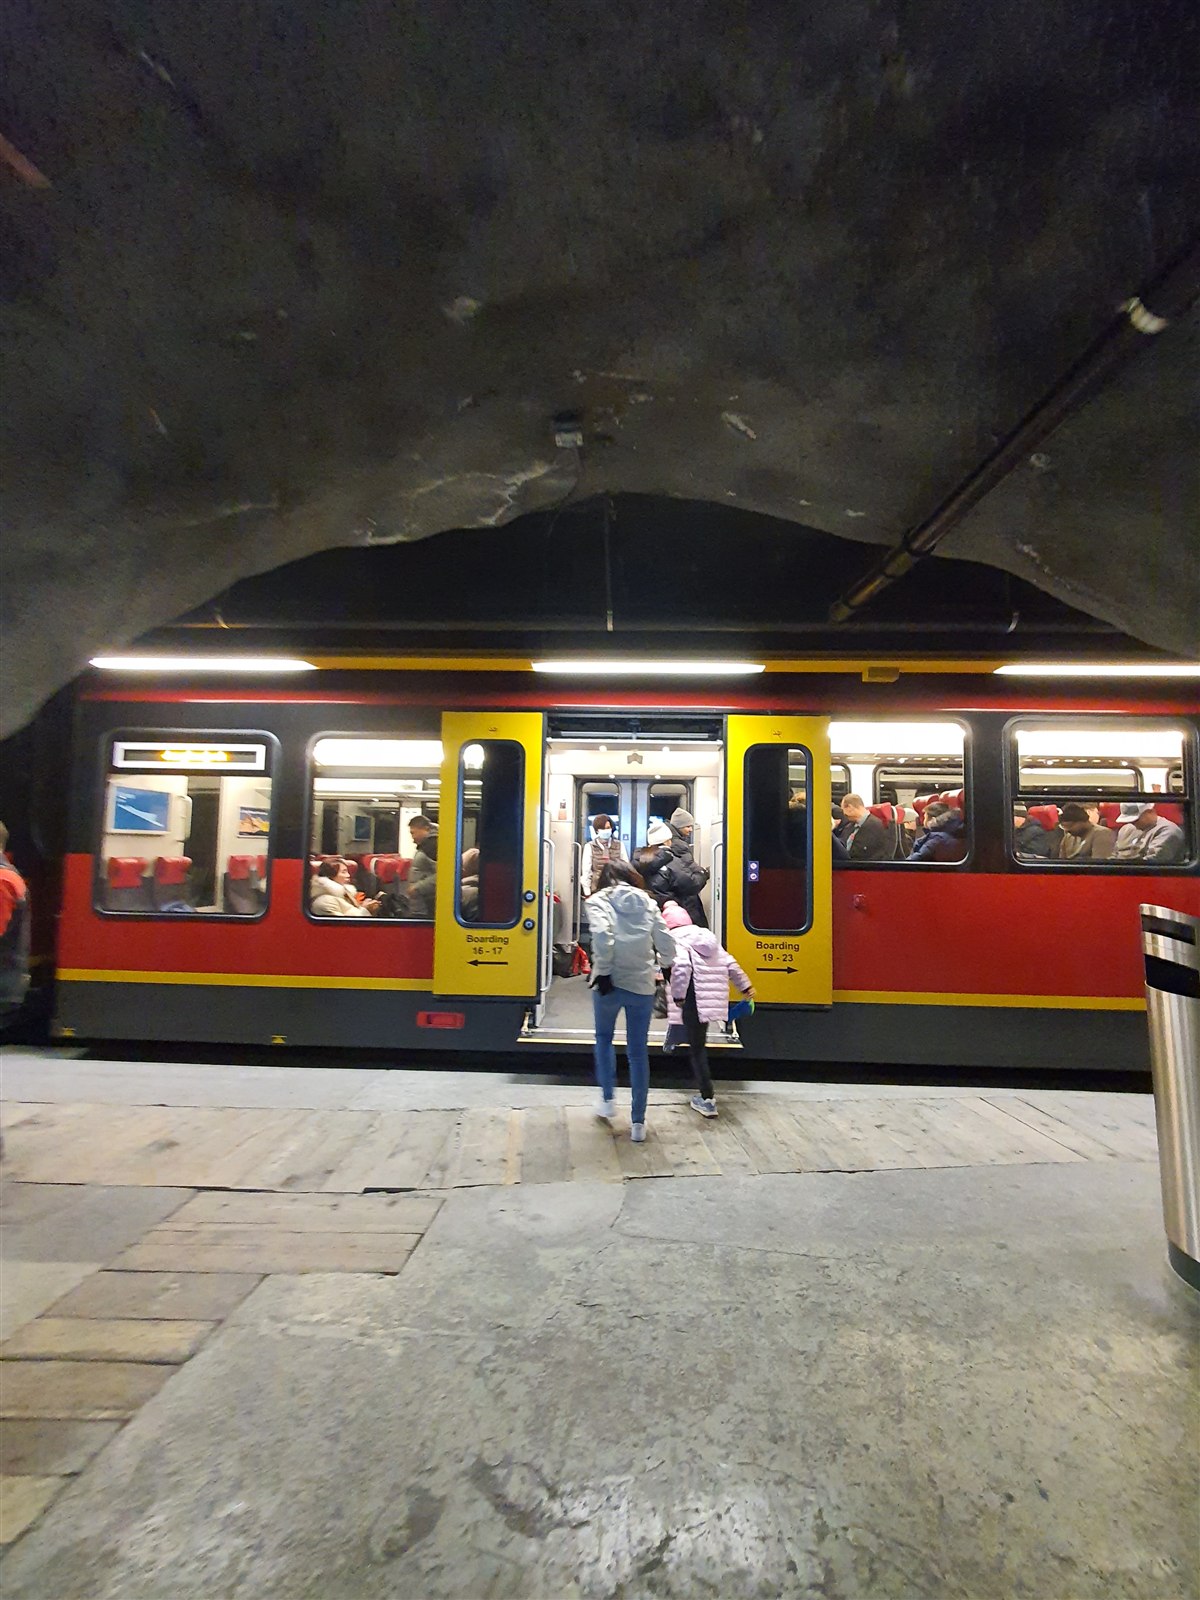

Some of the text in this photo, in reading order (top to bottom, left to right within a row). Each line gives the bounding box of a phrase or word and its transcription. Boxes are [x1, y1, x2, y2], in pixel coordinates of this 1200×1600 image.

[466, 934, 510, 946] Boarding
[492, 946, 503, 955] 17
[756, 940, 800, 953] Boarding
[762, 953, 774, 962] 19
[782, 953, 794, 962] 23
